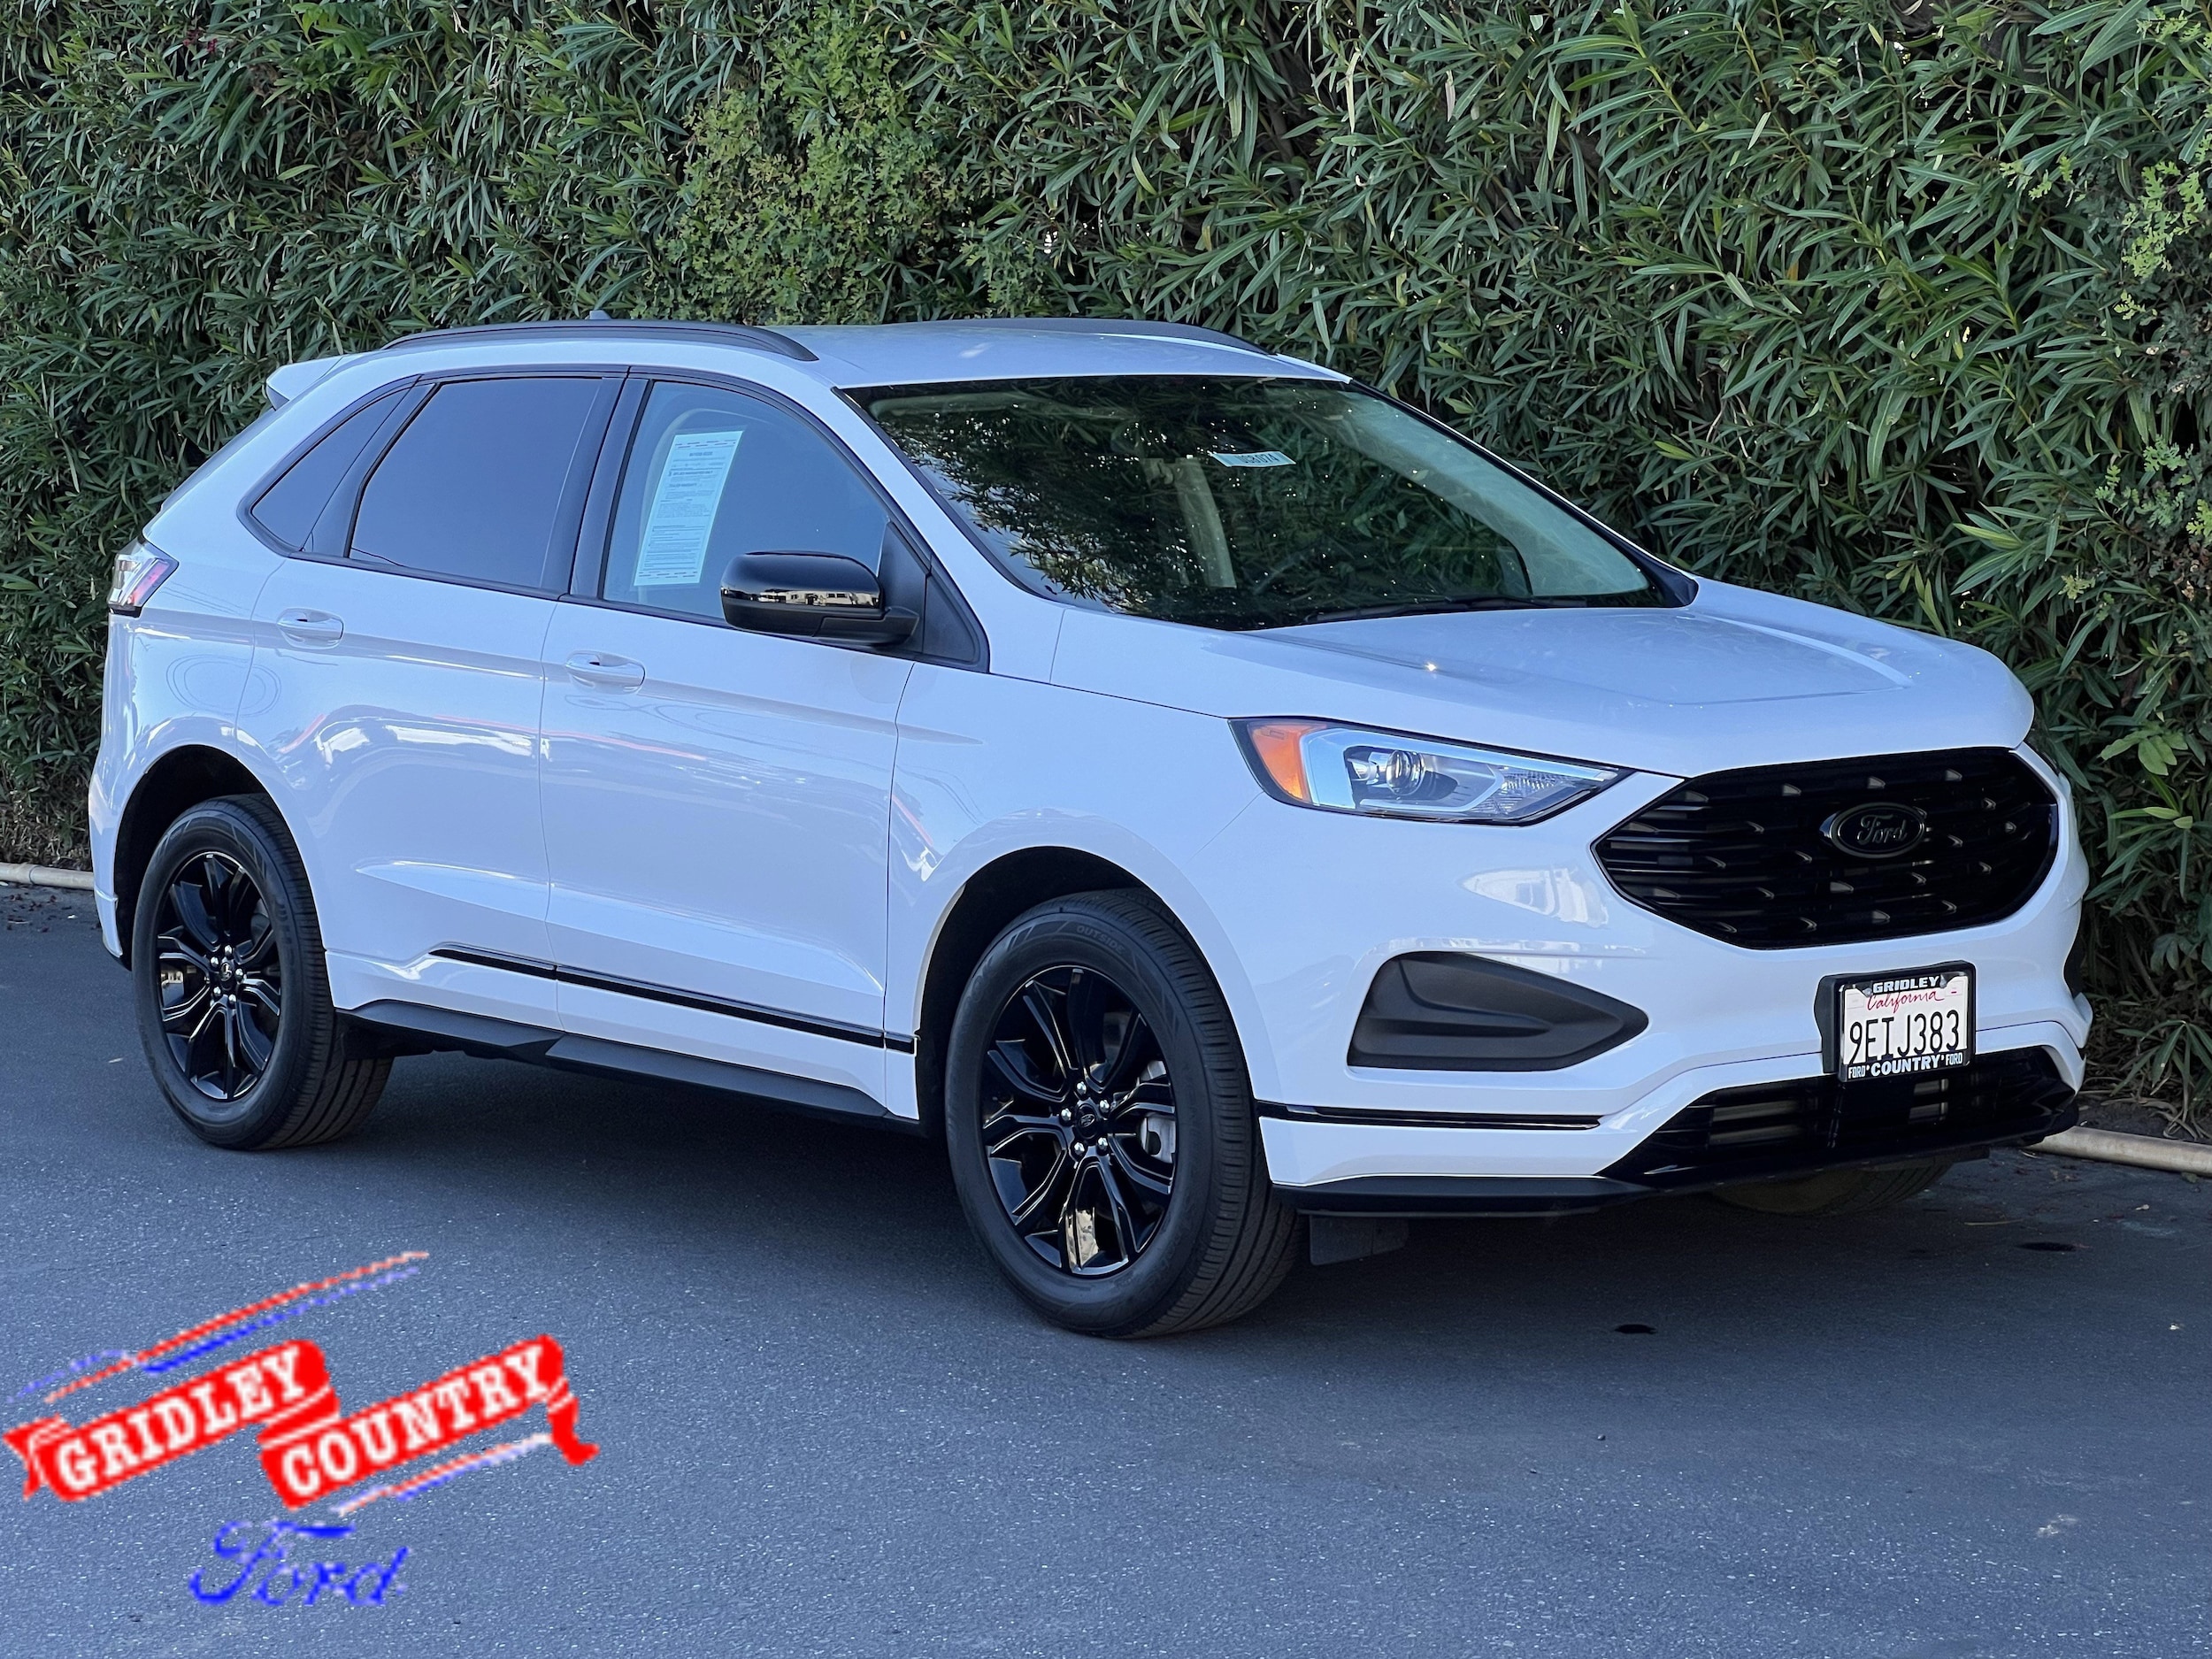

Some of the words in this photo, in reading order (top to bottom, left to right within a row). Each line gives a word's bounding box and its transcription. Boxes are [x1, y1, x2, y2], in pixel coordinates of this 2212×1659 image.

[1857, 814, 1908, 845] Ford
[1076, 925, 1126, 955] OUTSIDE
[1872, 976, 1939, 994] GRIDLEY
[1867, 990, 1945, 1014] California
[1847, 1065, 1866, 1079] FORD
[1945, 1052, 1963, 1066] FORD
